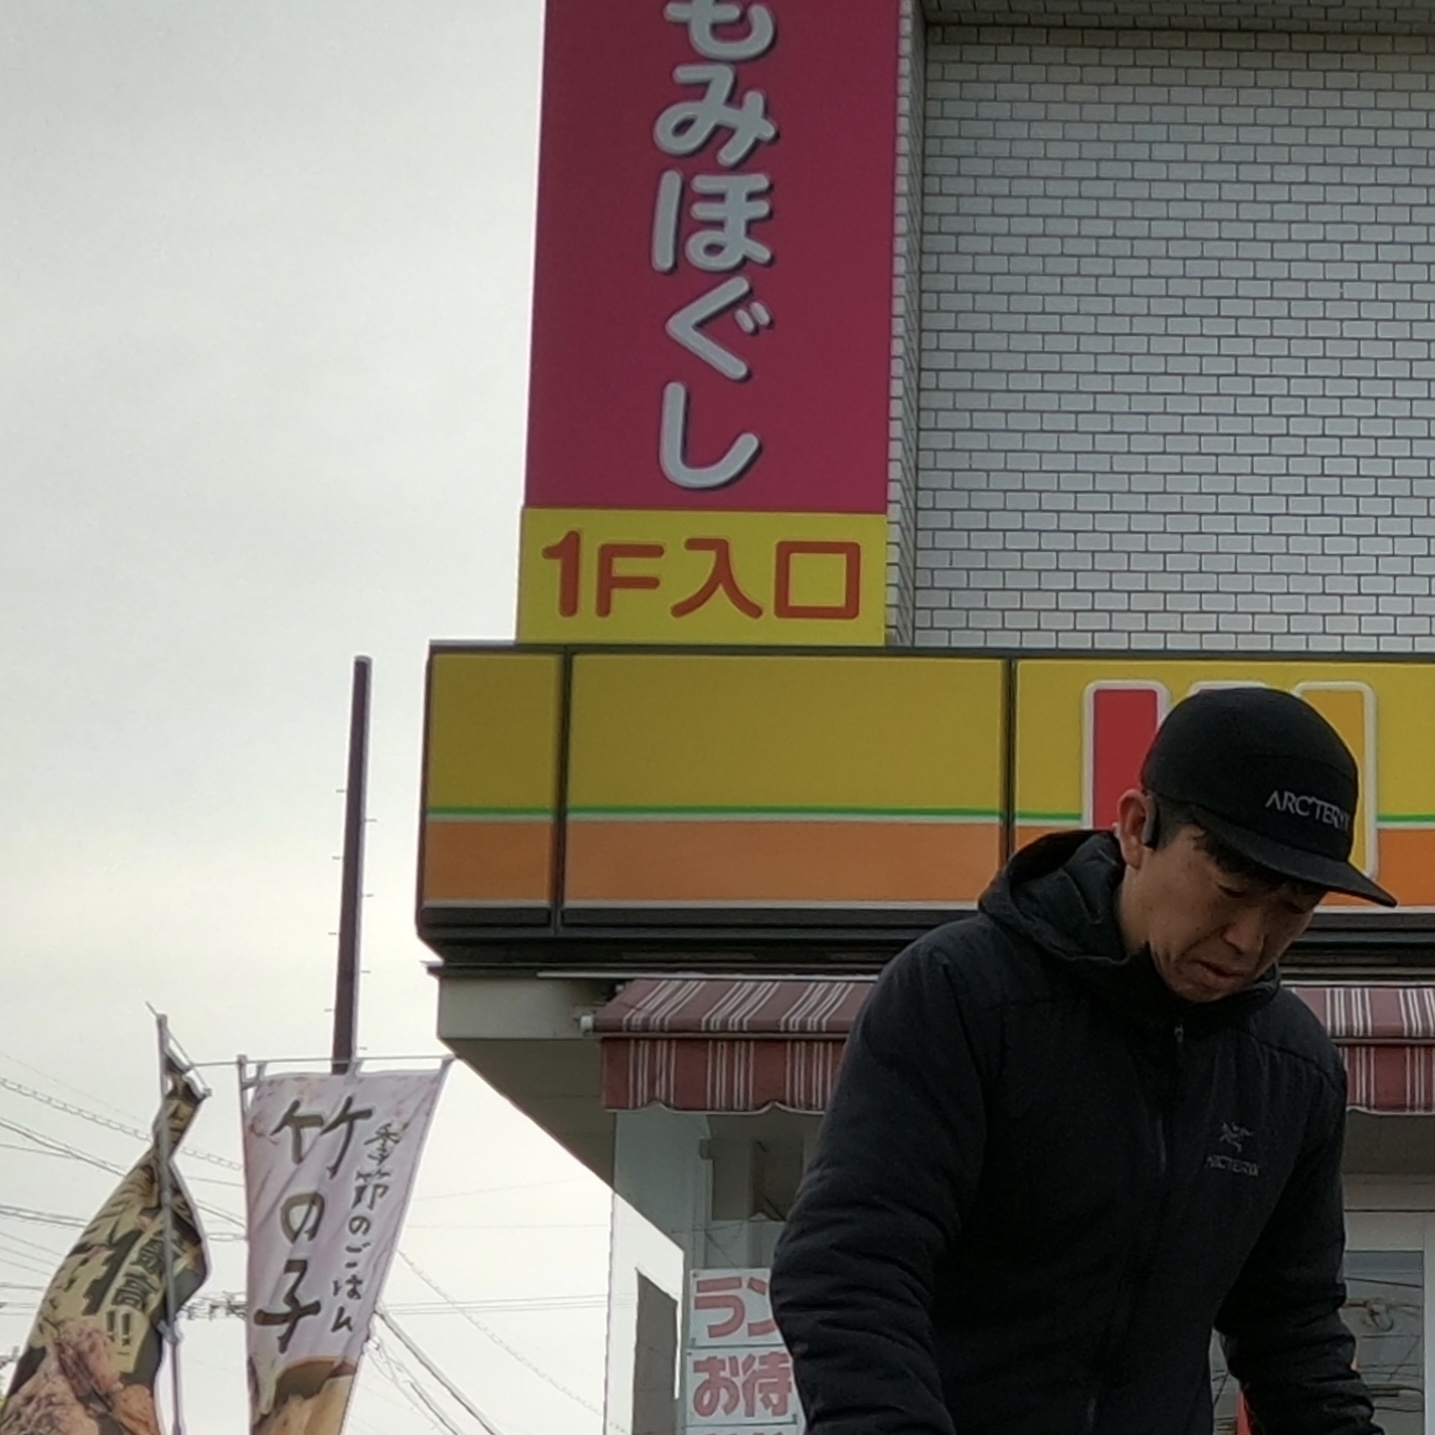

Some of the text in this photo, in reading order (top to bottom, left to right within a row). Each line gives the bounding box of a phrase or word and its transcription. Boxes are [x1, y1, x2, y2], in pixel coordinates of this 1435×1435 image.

[653, 0, 776, 490] もみほぐし
[541, 529, 862, 620] 1F入口
[254, 1095, 373, 1353] 竹の子
[331, 1122, 399, 1333] 季節のごはん
